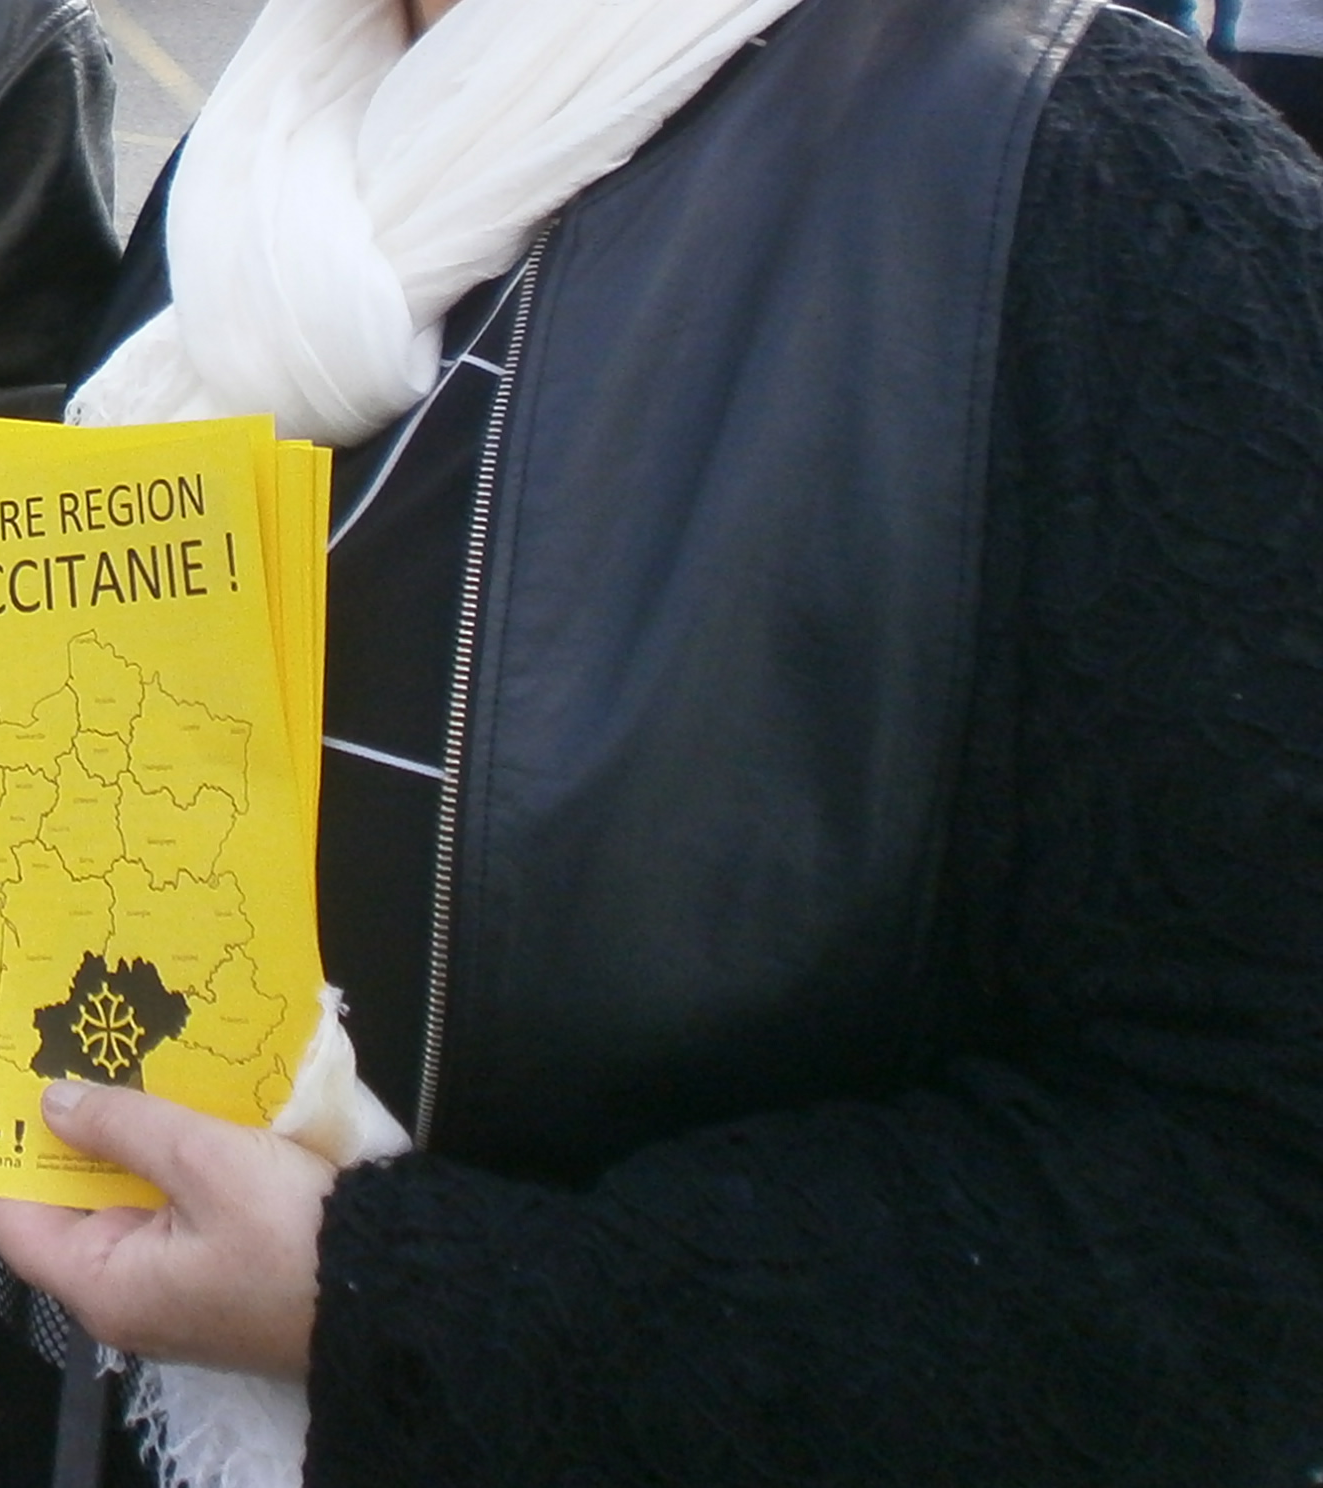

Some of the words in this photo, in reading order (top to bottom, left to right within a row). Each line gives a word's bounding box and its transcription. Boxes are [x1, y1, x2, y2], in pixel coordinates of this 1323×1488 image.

[59, 473, 205, 535] REGION
[225, 532, 239, 592] !
[14, 1119, 26, 1153] !
